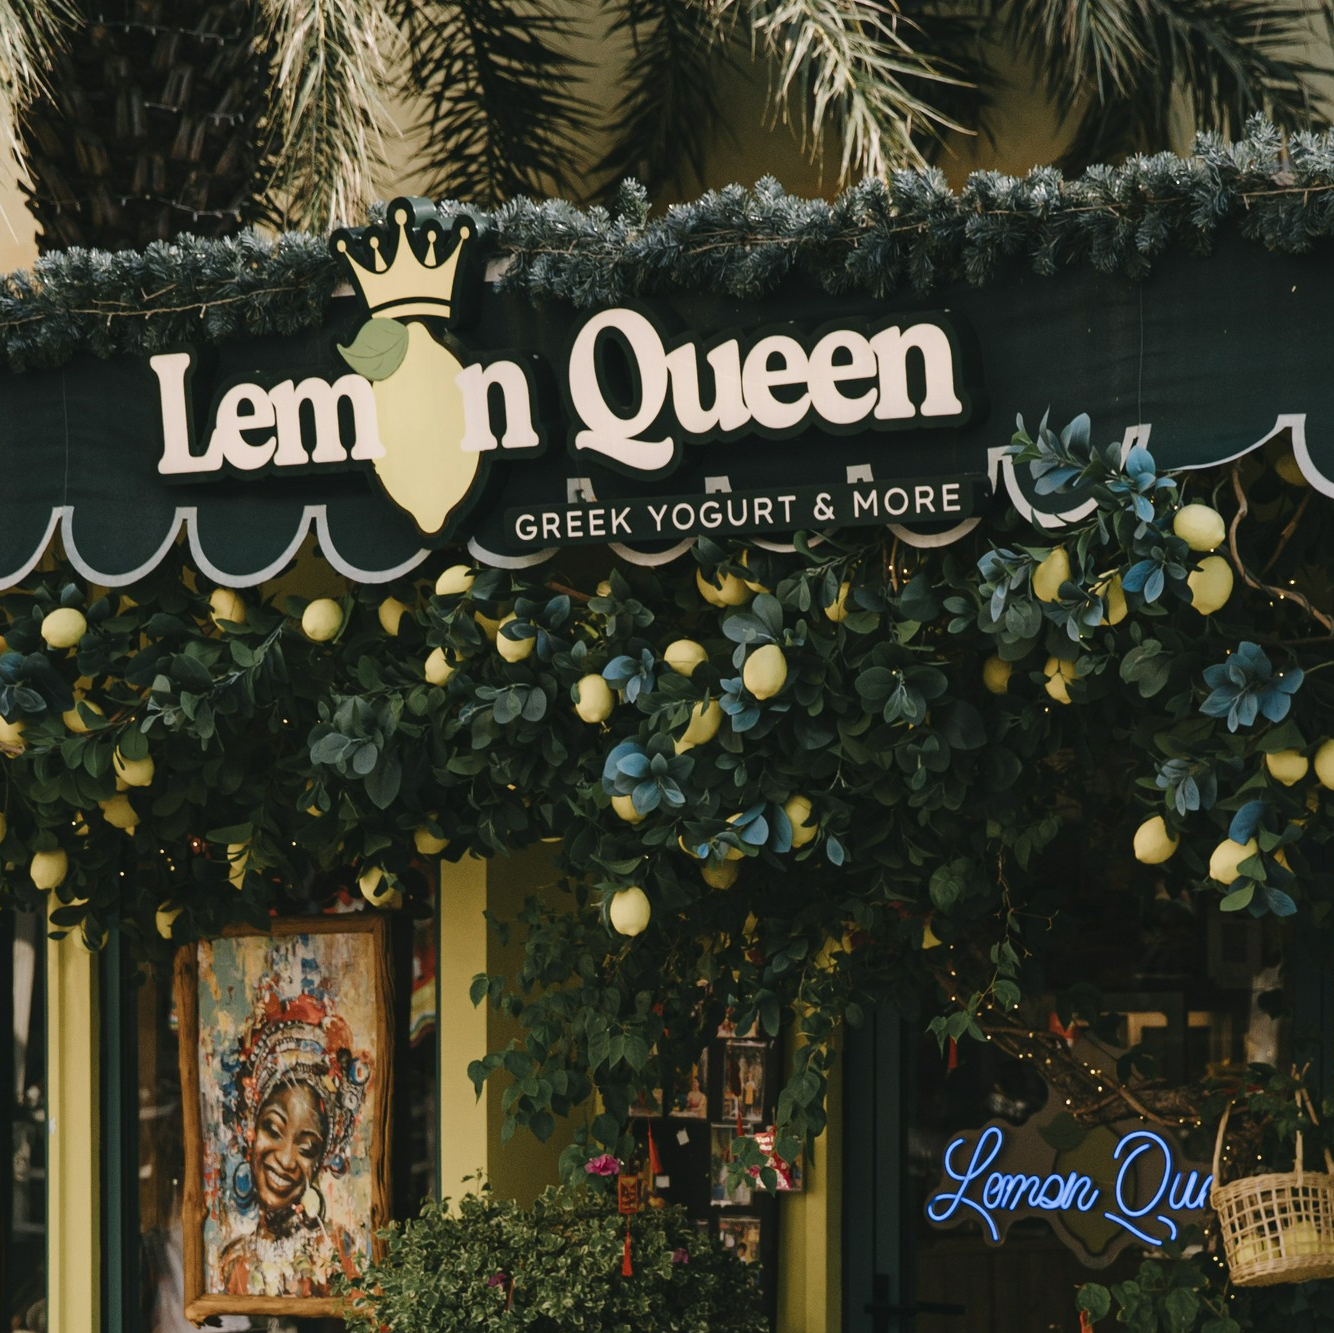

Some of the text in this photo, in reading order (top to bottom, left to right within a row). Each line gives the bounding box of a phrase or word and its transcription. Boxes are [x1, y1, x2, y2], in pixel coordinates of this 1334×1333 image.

[568, 308, 962, 470] Queen
[516, 484, 962, 543] GREEK YOGURT & MORE
[927, 1126, 1100, 1241] Lemon
